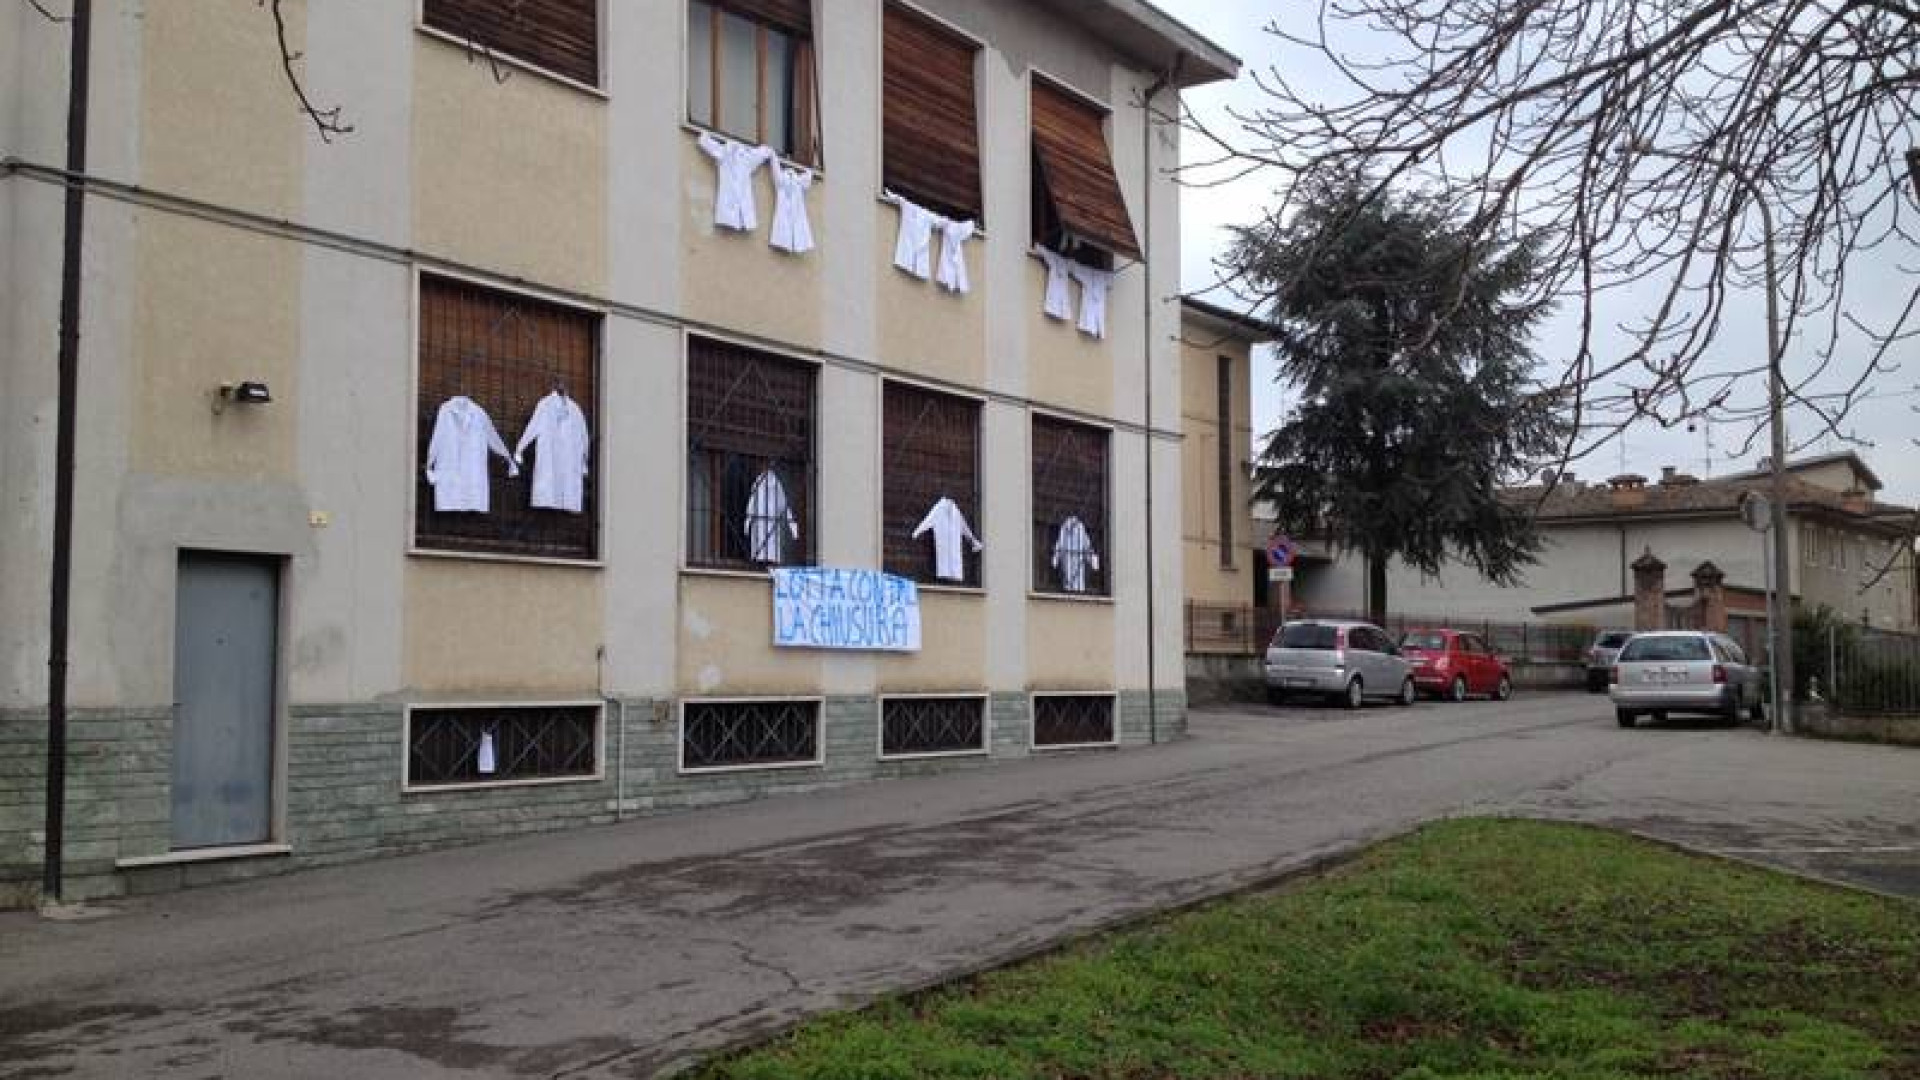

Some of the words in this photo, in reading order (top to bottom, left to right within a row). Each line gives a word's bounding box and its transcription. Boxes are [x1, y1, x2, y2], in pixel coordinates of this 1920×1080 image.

[776, 568, 846, 601] LOTTA
[777, 605, 808, 642] LA
[811, 603, 909, 647] CHIUSURA
